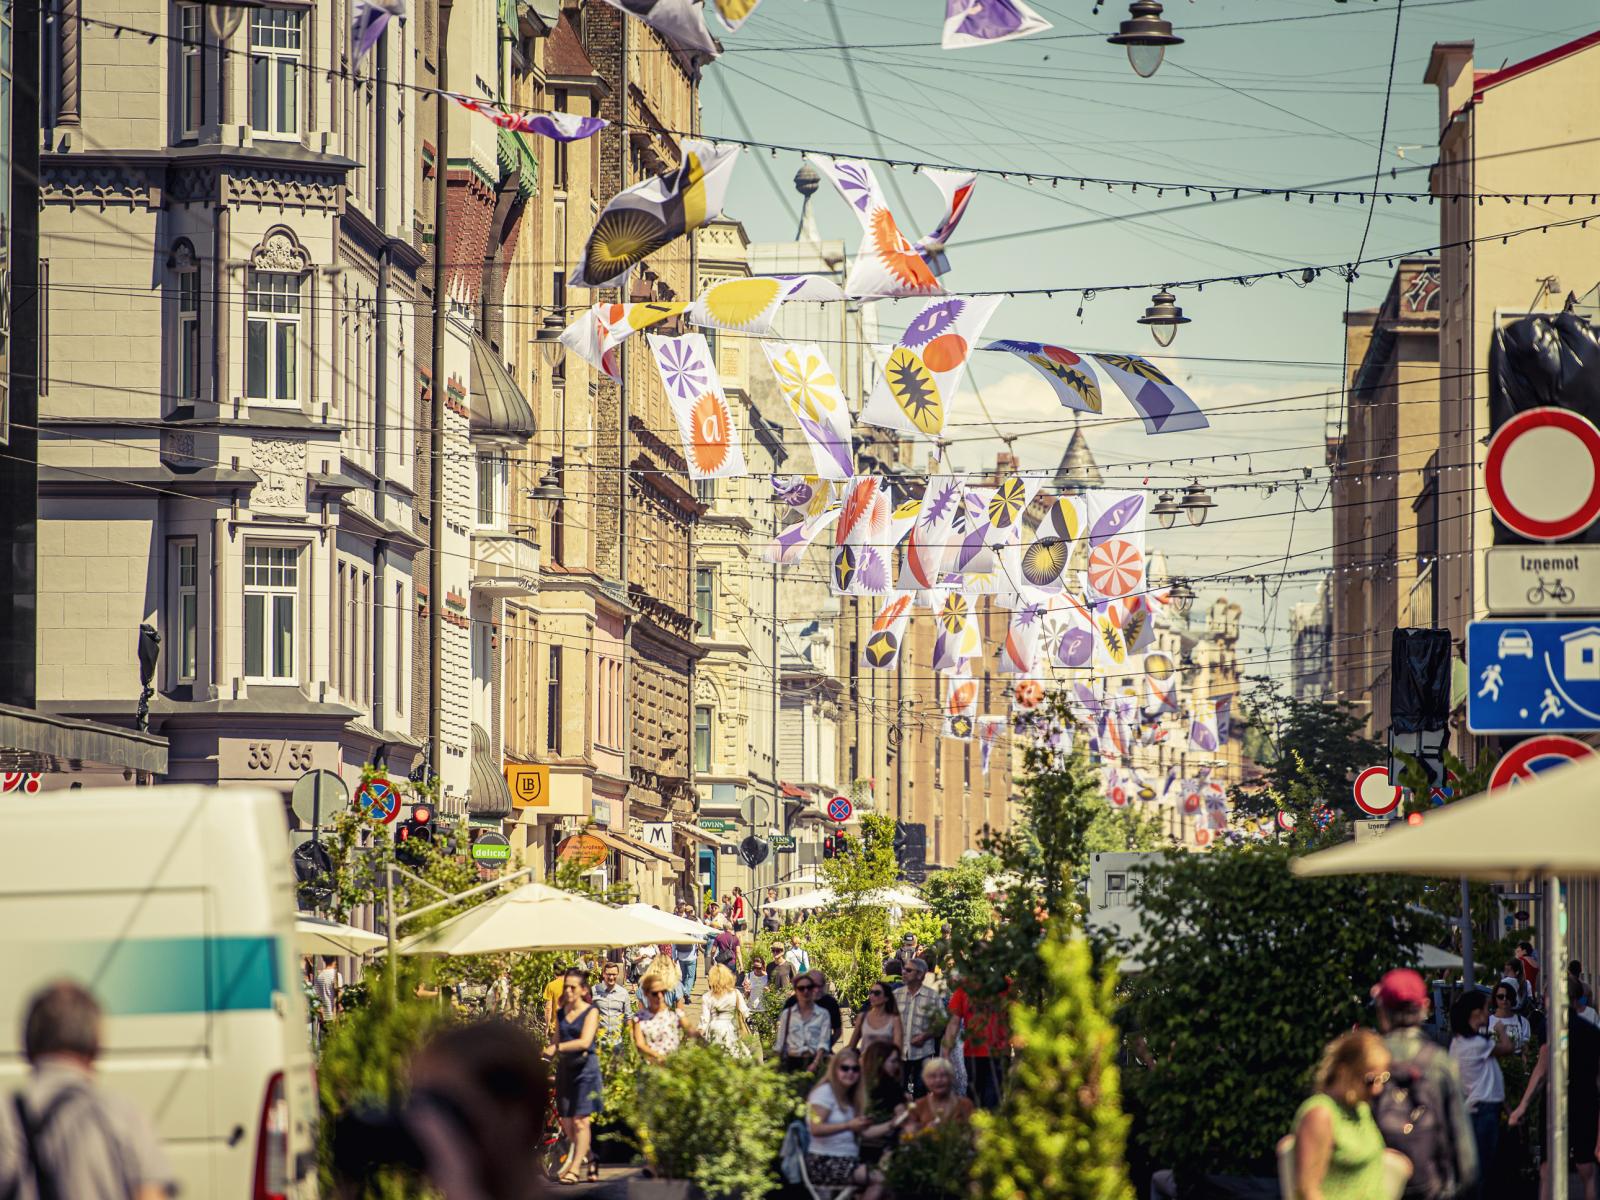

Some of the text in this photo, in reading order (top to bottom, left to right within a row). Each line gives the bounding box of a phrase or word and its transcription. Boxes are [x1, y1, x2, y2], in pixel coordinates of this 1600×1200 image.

[702, 414, 721, 443] a
[522, 778, 535, 791] LB
[649, 826, 667, 844] M
